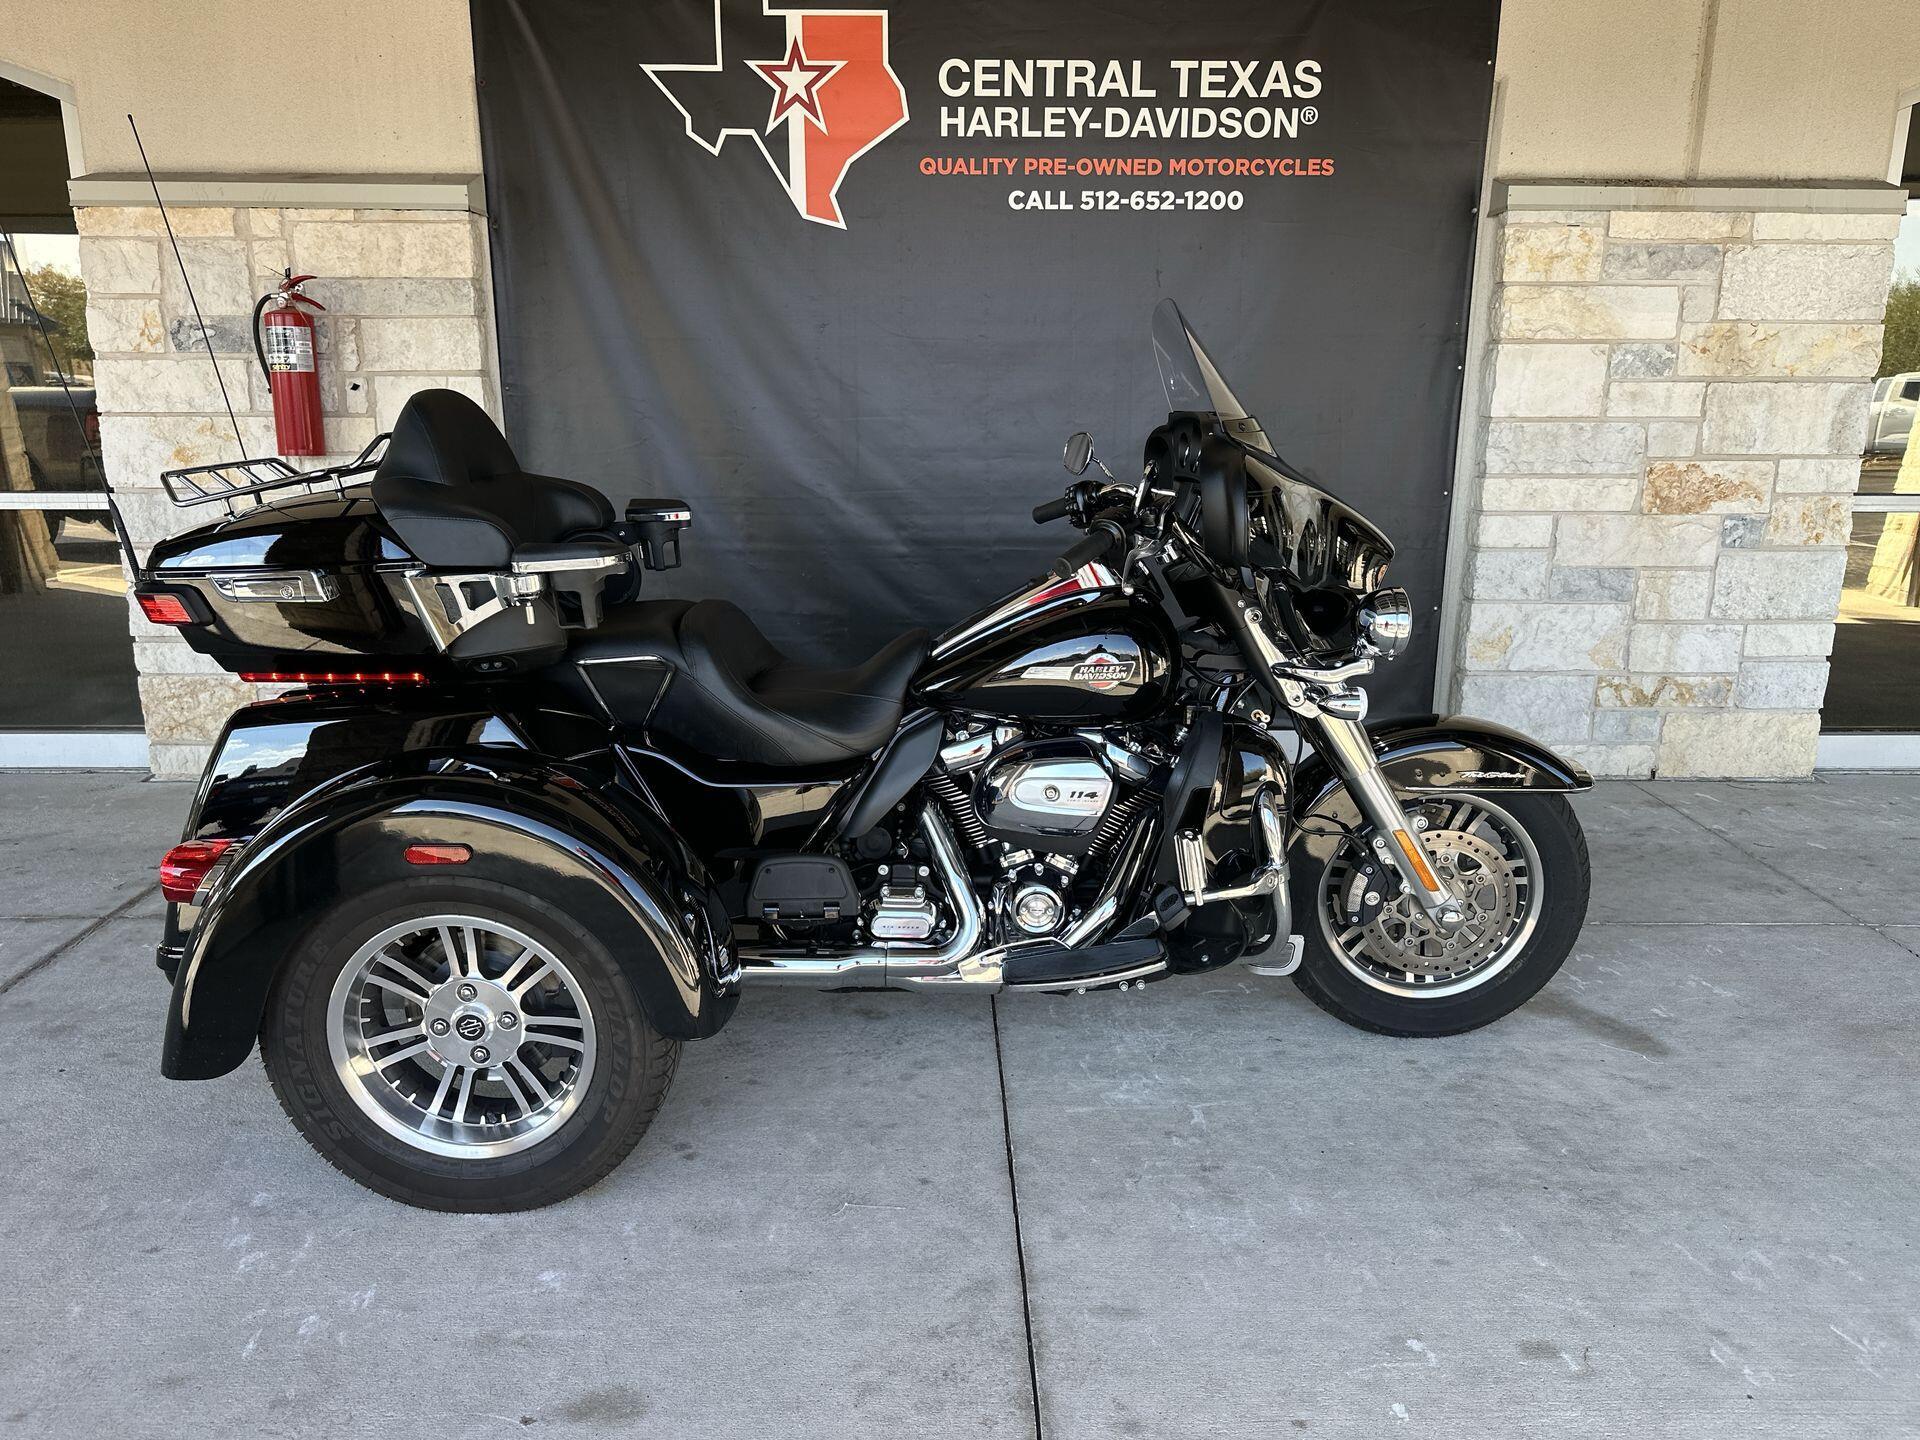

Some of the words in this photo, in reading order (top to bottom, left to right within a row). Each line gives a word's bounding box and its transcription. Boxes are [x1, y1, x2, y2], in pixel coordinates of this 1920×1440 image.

[938, 59, 1156, 97] CENTRAL
[1170, 60, 1322, 98] TEXAS
[919, 157, 1018, 177] QUALITY
[1023, 159, 1162, 176] PRE-OWNED
[1168, 159, 1335, 176] MOTORCYCLES
[1008, 191, 1073, 211] CALL
[1079, 191, 1244, 211] 512-652-1200
[1073, 672, 1127, 680] DAVIDSON
[1080, 665, 1127, 673] HARLEY-
[1070, 791, 1098, 799] 114
